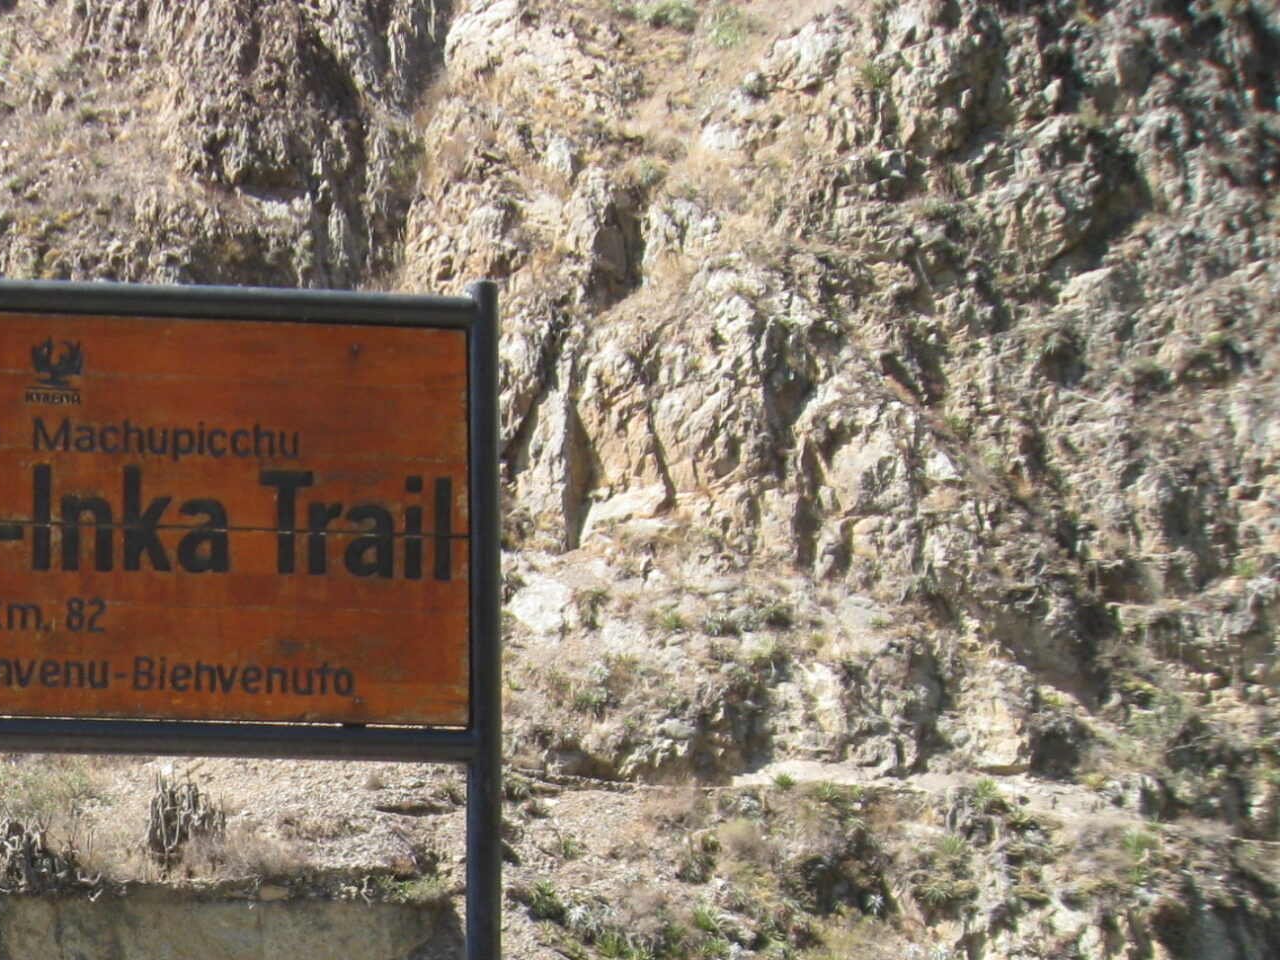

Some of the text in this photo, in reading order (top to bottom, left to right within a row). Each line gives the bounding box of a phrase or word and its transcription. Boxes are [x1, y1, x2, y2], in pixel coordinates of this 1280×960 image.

[32, 416, 301, 461] Machupicchu
[258, 470, 453, 581] Trail
[65, 598, 107, 633] 82
